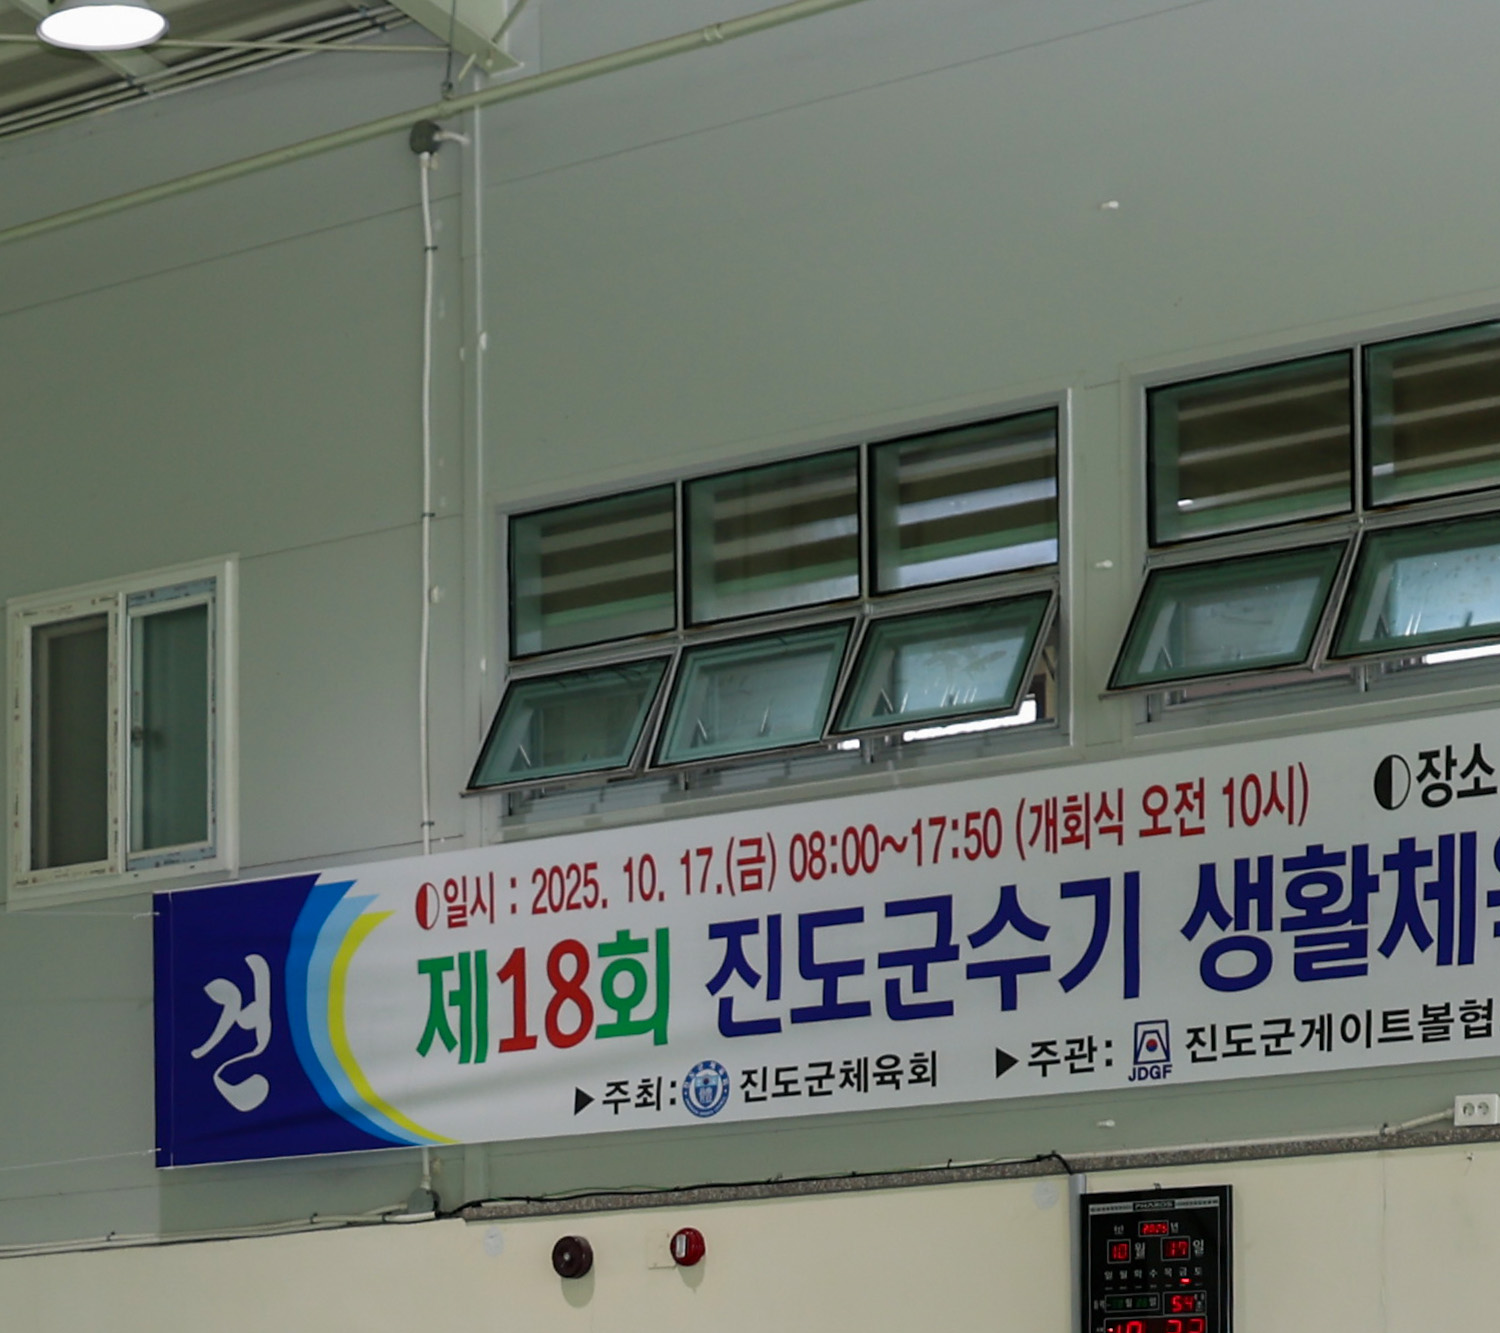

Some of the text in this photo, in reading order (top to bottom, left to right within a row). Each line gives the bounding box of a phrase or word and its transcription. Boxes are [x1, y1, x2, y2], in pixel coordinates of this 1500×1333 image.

[1415, 741, 1499, 809] 장소
[442, 871, 496, 929] 일시
[531, 861, 608, 916] 2025.
[623, 853, 665, 903] 10.
[680, 830, 777, 897] 17.(금)
[789, 806, 1003, 883] 08:00~17:50
[1016, 786, 1125, 861] (개회식
[1138, 776, 1206, 839] 오전
[1221, 760, 1310, 830] 10시)
[416, 926, 670, 1065] 제18회
[705, 871, 1141, 1039] 진도군수기
[601, 1075, 678, 1116] 주최:
[739, 1049, 939, 1104] 진도군체육회
[1026, 1035, 1115, 1080] 주관:
[1128, 1064, 1173, 1082] JDGF
[1112, 1243, 1128, 1260] 10
[1170, 1240, 1189, 1257] 17
[1171, 1294, 1194, 1313] 54
